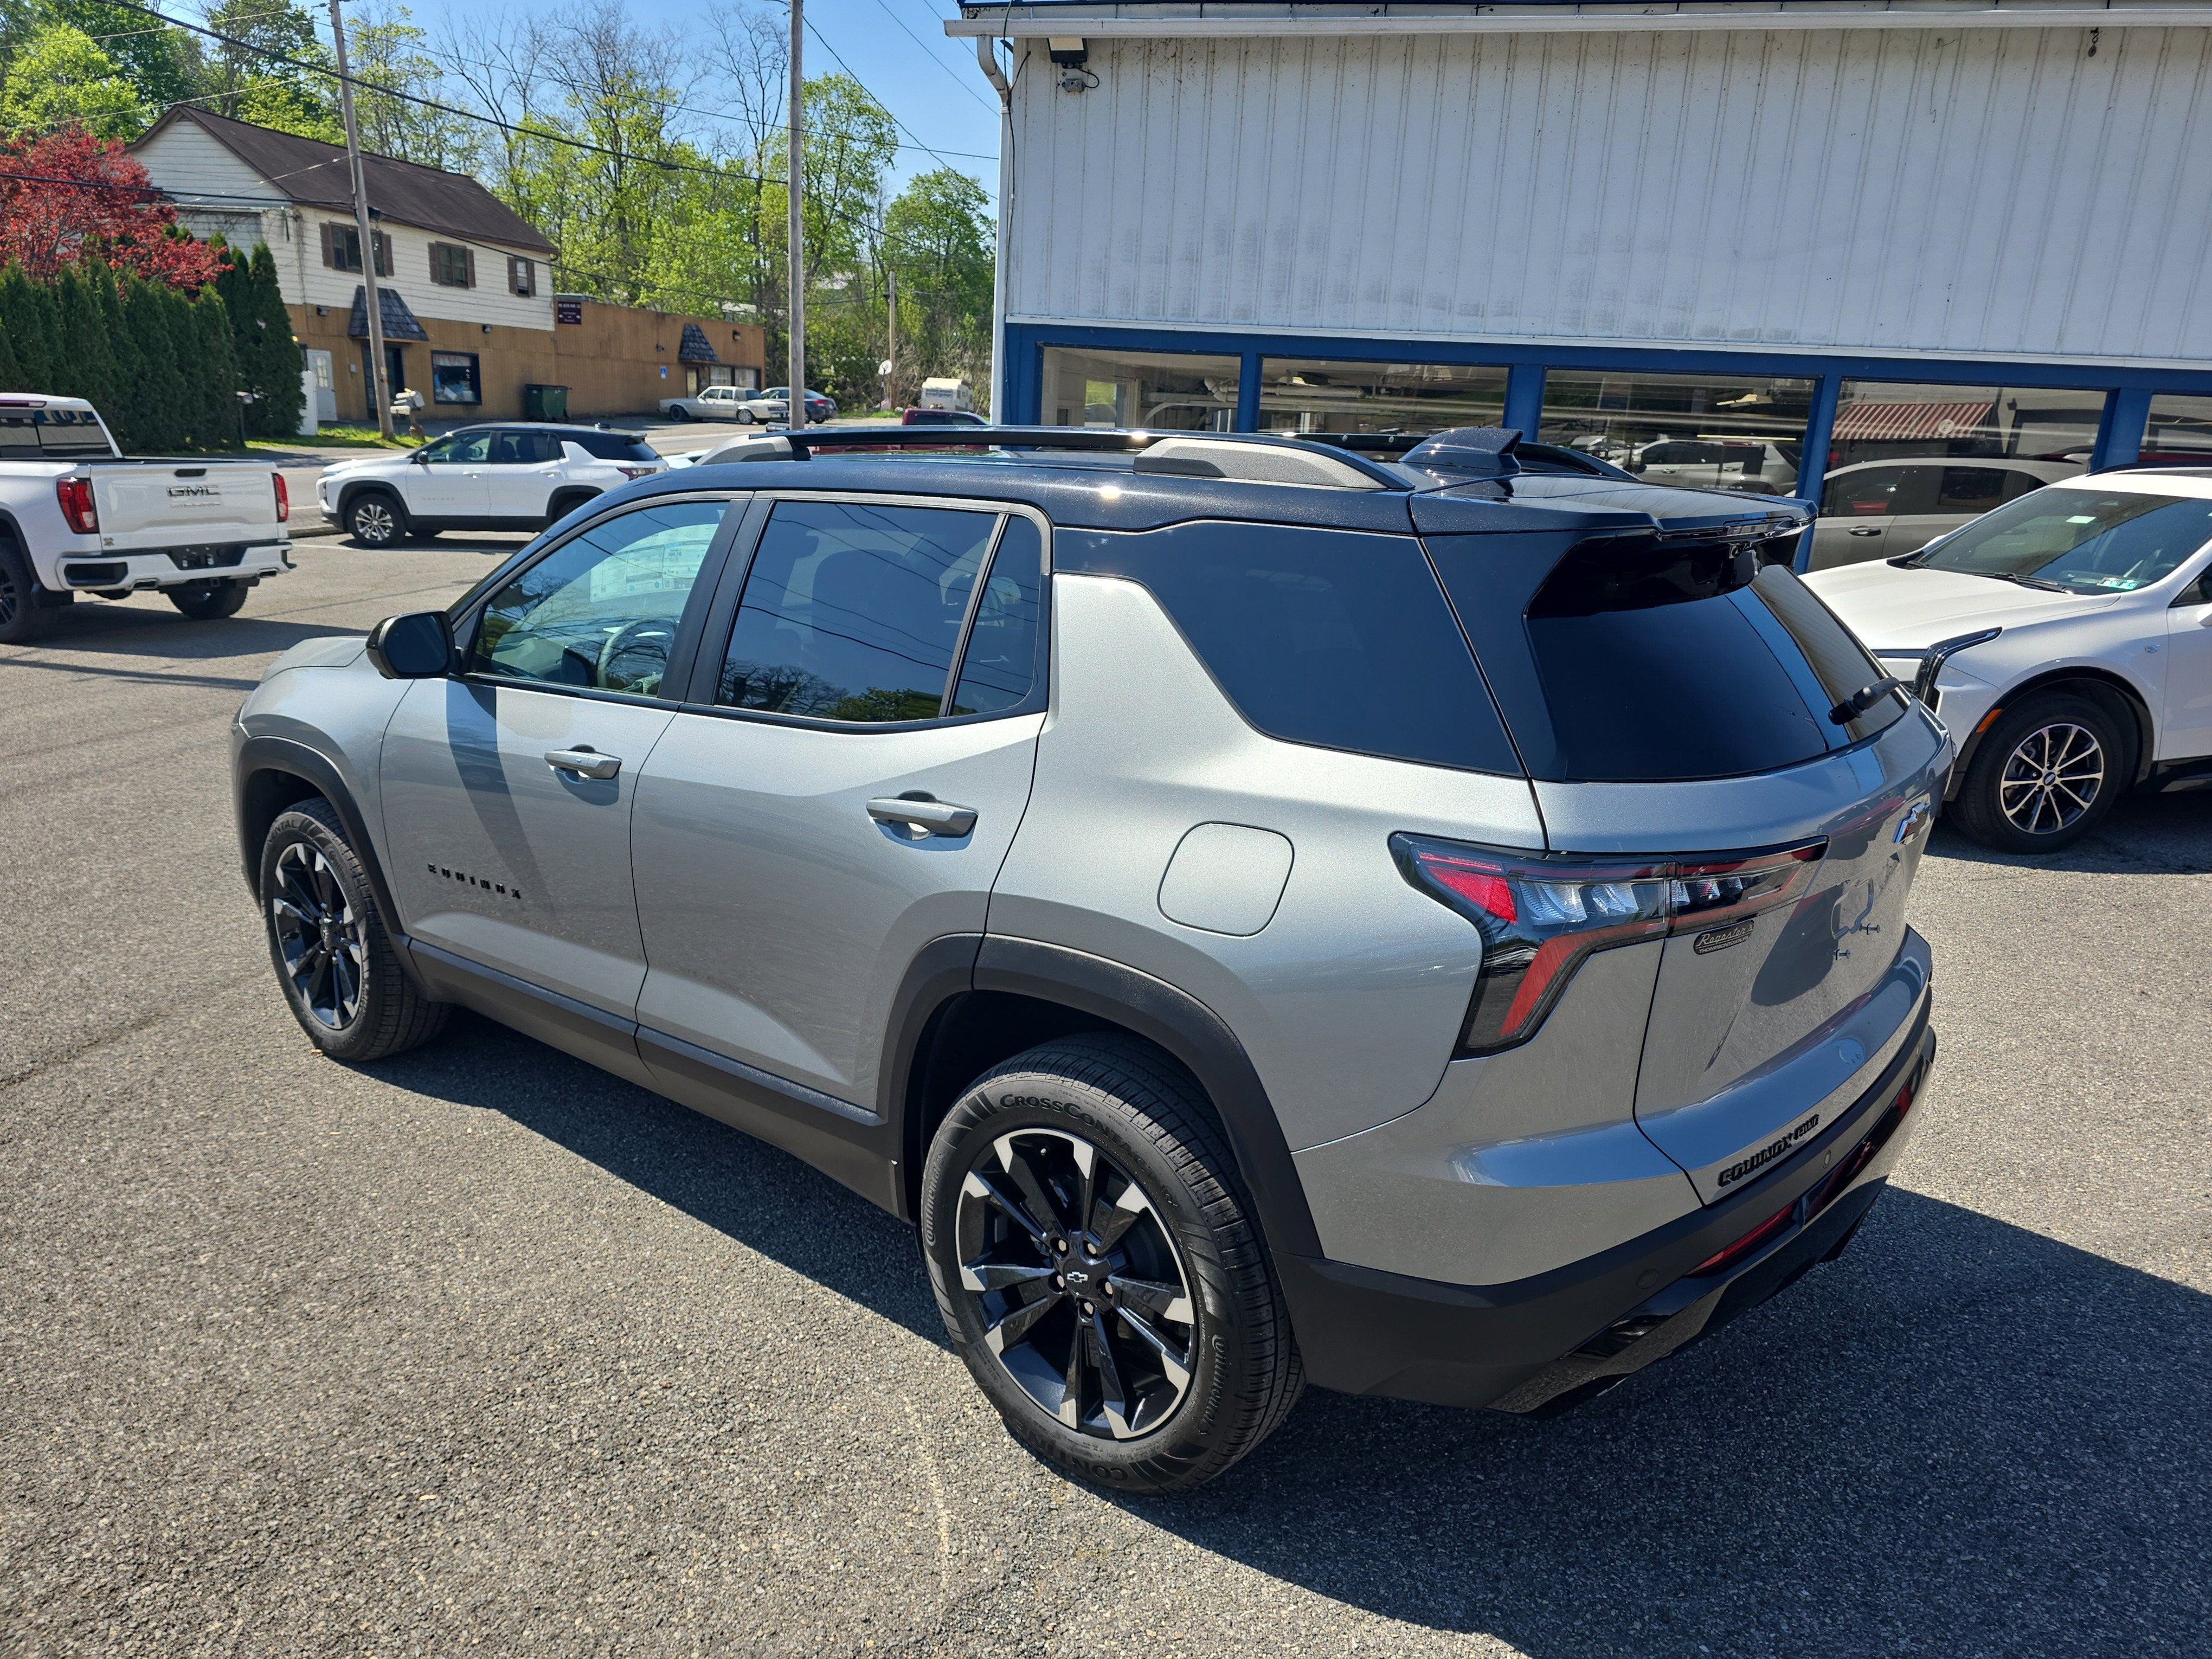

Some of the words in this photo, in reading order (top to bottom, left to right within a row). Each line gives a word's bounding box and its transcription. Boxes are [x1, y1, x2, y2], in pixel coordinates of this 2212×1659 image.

[166, 485, 221, 497] GMC
[427, 862, 522, 899] EQUINOX
[1718, 1133, 1793, 1187] EQUINOX
[925, 1161, 942, 1246] Continental
